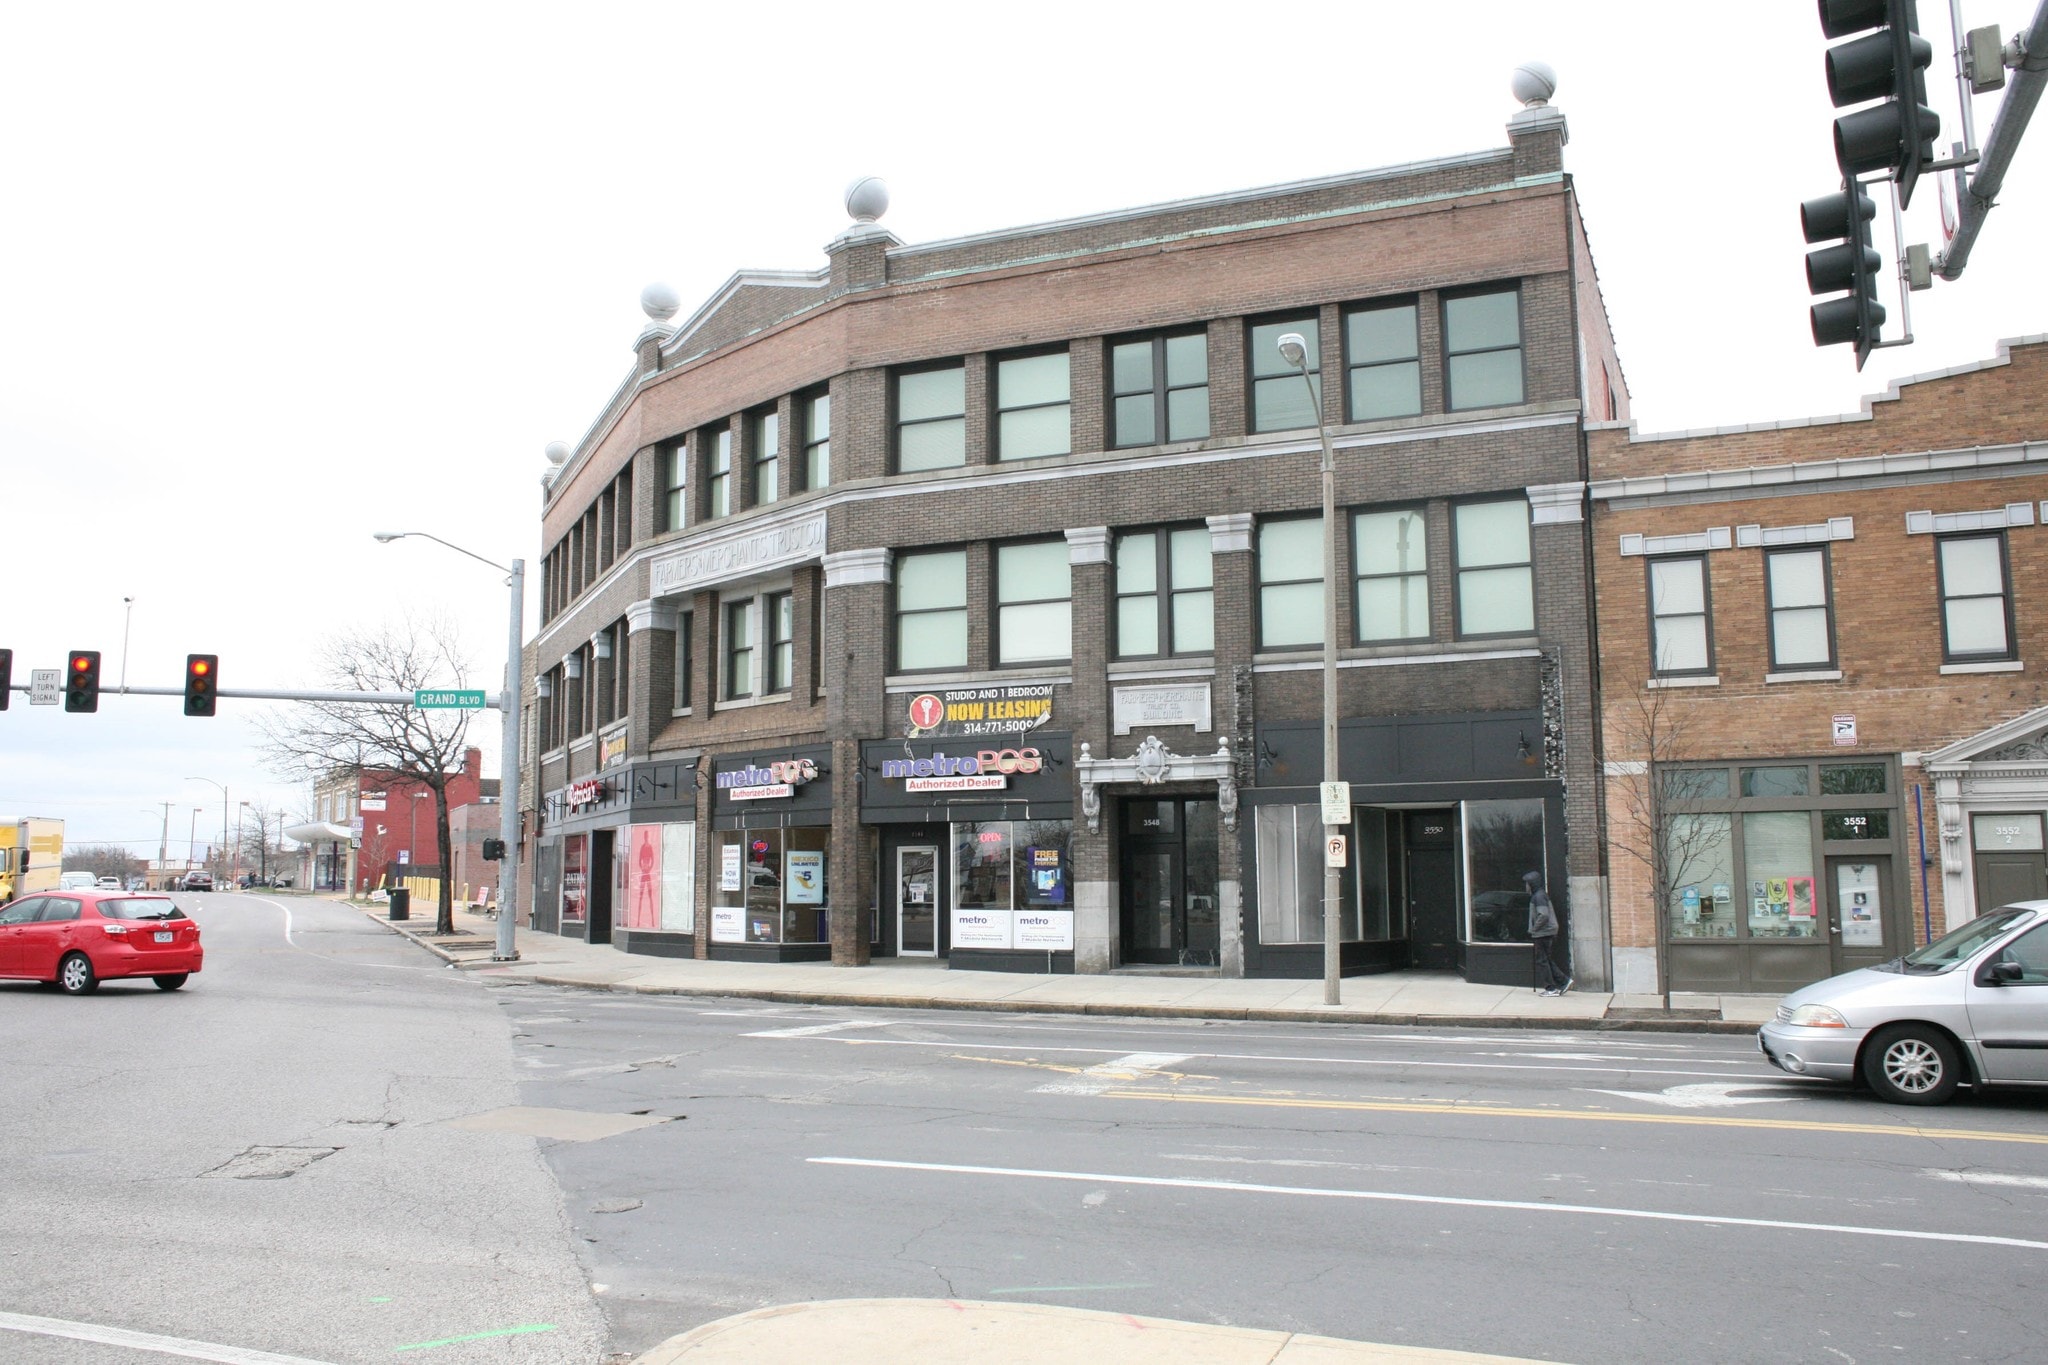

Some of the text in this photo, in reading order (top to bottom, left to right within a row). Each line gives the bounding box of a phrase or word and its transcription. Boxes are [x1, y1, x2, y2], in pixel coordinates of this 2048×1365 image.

[769, 526, 805, 557] TRUST
[38, 673, 55, 681] LEFT
[37, 683, 55, 691] TURN
[33, 694, 57, 702] SIGNAL
[945, 686, 1053, 701] STUDIO AND 1 BEDROOM
[420, 693, 480, 705] GRAND BLVD
[946, 698, 1052, 721] NOW LEASING
[882, 747, 1040, 778] metroPCS
[716, 759, 815, 789] metroPCS
[908, 776, 1003, 790] Authorized Dealer
[731, 786, 788, 798] Authorized Dealer
[1843, 816, 1867, 826] 3552
[1424, 826, 1444, 835] 3550
[1852, 825, 1859, 834] 1
[1995, 826, 2021, 835] 3552
[979, 832, 1002, 843] OPEN
[2005, 835, 2013, 844] 2
[1034, 850, 1058, 858] FREE
